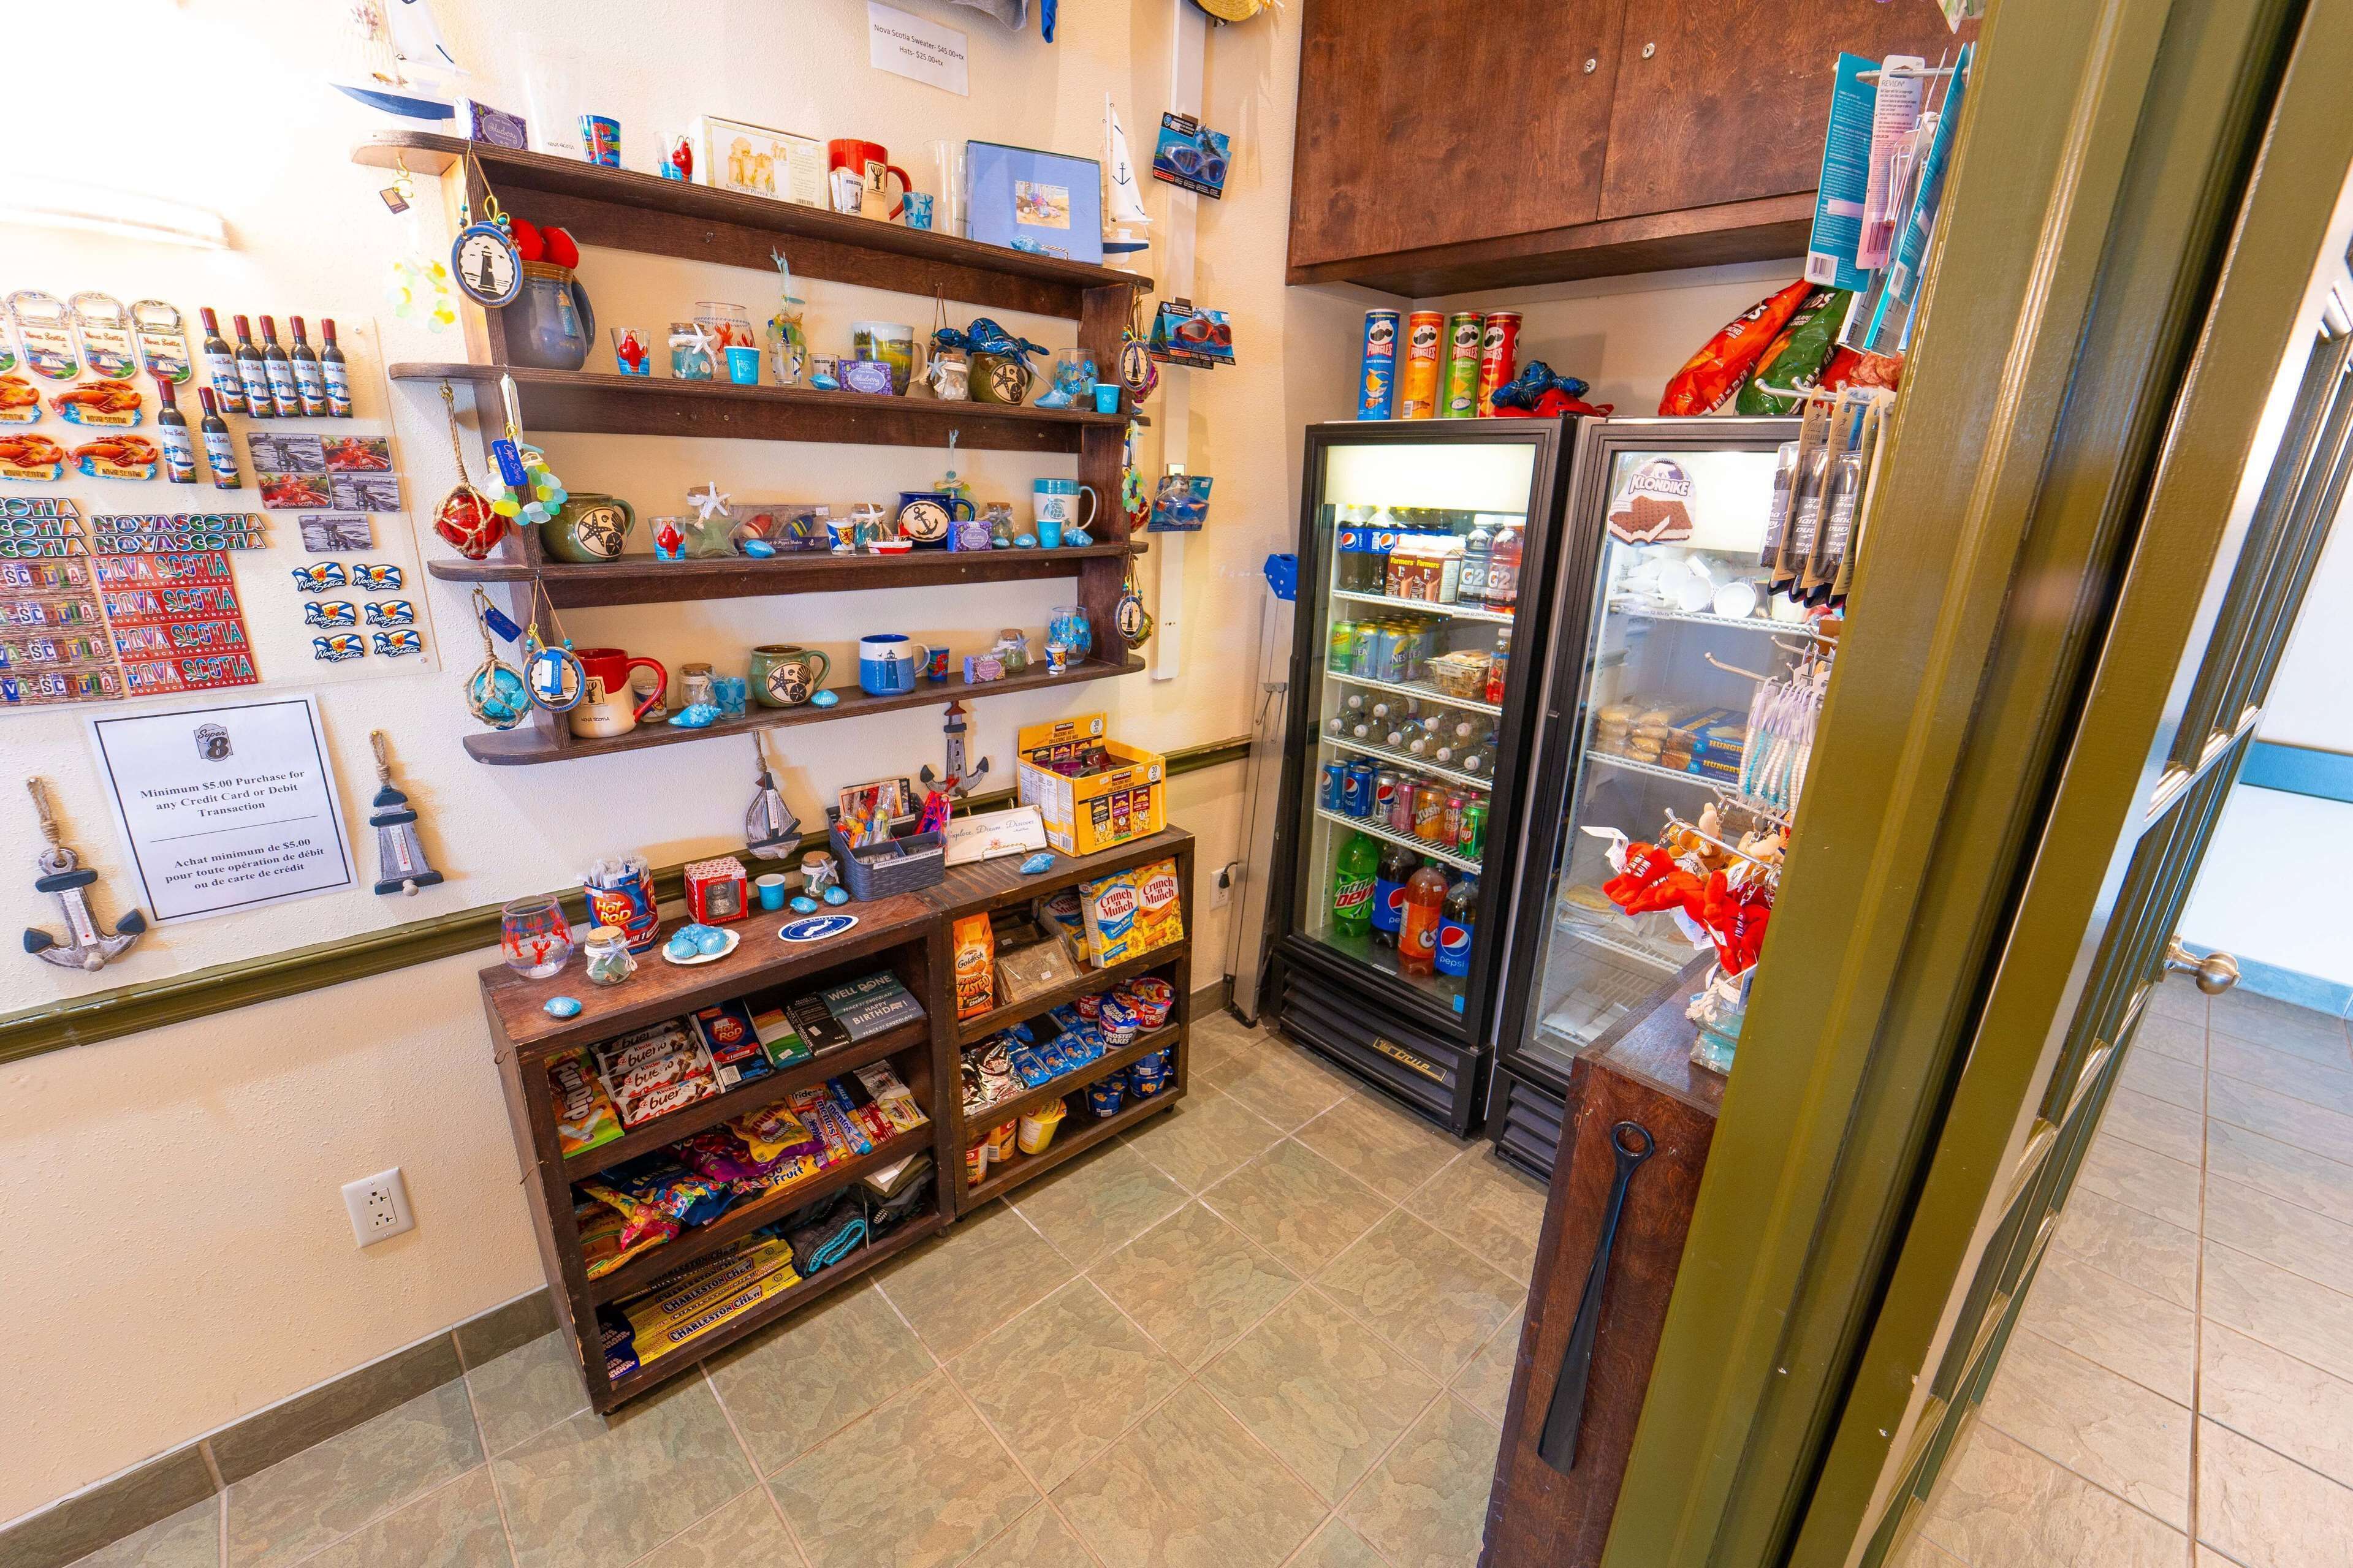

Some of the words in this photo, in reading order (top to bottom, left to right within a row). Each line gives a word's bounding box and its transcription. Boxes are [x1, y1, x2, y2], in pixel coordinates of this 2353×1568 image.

[874, 25, 890, 34] Nova
[892, 29, 910, 41] Scotia
[911, 36, 936, 50] Sweater-
[938, 45, 964, 60] $45.00+tx
[900, 46, 914, 55] Hats-
[916, 51, 943, 66] $25.00+tx
[25, 331, 43, 340] Nova
[45, 333, 66, 342] Scotia
[85, 331, 102, 340] Nova
[104, 333, 124, 342] Scotia
[162, 338, 181, 347] Scotia
[1367, 343, 1393, 356] PRINGLES
[1410, 347, 1435, 360] PRINGLES
[1453, 347, 1478, 359] PRINGLES
[1629, 474, 1690, 496] KLONDIKE
[97, 556, 153, 583] NOVA
[154, 554, 230, 579] SCOTIA
[1390, 557, 1414, 566] Farmers
[1416, 559, 1440, 569] Farmers
[353, 577, 376, 586] Nova
[368, 582, 399, 591] Scotia
[1462, 568, 1485, 583] G2
[1488, 571, 1510, 589] G2
[299, 580, 318, 589] Nova
[314, 580, 346, 592] Scotia
[101, 593, 161, 617] NOVA
[162, 587, 237, 614] SCOTIA
[306, 615, 329, 624] Nova
[321, 619, 355, 629] Scotia
[367, 614, 389, 624] Nova
[381, 618, 412, 627] Scotia
[112, 627, 170, 653] NOVA
[172, 623, 244, 648] SCOTIA
[316, 648, 338, 659] Nova
[331, 651, 363, 662] Scotia
[376, 644, 395, 654] Nova
[390, 646, 420, 657] Scotia
[123, 661, 186, 687] NOVA
[181, 656, 254, 681] SCOTIA
[215, 677, 256, 686] CANADA
[197, 729, 226, 742] Super
[206, 737, 229, 759] 8
[140, 784, 199, 798] Minimum
[202, 779, 232, 790] $5.00
[236, 773, 286, 786] Purchase
[289, 770, 305, 779] for
[156, 801, 177, 811] any
[181, 795, 218, 806] Credit
[221, 790, 250, 801] Card
[268, 783, 298, 794] Debit
[197, 801, 265, 817] Transaction
[1416, 804, 1440, 825] Crush
[175, 857, 208, 868] Achat
[211, 847, 265, 862] minimum
[283, 838, 311, 850] $5.00
[165, 872, 193, 884] pour
[197, 866, 226, 877] toute
[228, 857, 280, 872] opération
[298, 847, 324, 858] débit
[194, 881, 208, 890] ou
[211, 877, 225, 887] de
[228, 873, 256, 884] carte
[259, 869, 271, 878] de
[274, 863, 305, 875] crédit
[1142, 877, 1174, 895] Crunch
[1100, 888, 1133, 907] Crunch
[1145, 888, 1174, 906] Munch
[1103, 901, 1133, 919] Munch
[957, 952, 984, 969] Goldfish
[1440, 956, 1465, 968] pepsi
[828, 987, 857, 1001] WELL
[858, 975, 892, 992] DONE
[865, 1001, 887, 1012] HAPPY
[866, 992, 893, 1005] CHOCOLATE
[969, 994, 987, 1006] Cheddar
[886, 1015, 913, 1027] CHOCOLATE
[1104, 1031, 1134, 1040] FROSTED
[1141, 1083, 1157, 1093] KD
[816, 1100, 836, 1134] mentos
[829, 1103, 853, 1133] mentos
[773, 1167, 804, 1186] Fruit
[661, 1274, 726, 1312] CHARLESTON
[669, 1303, 733, 1342] CHARLESTON
[733, 1286, 762, 1309] CHEW
